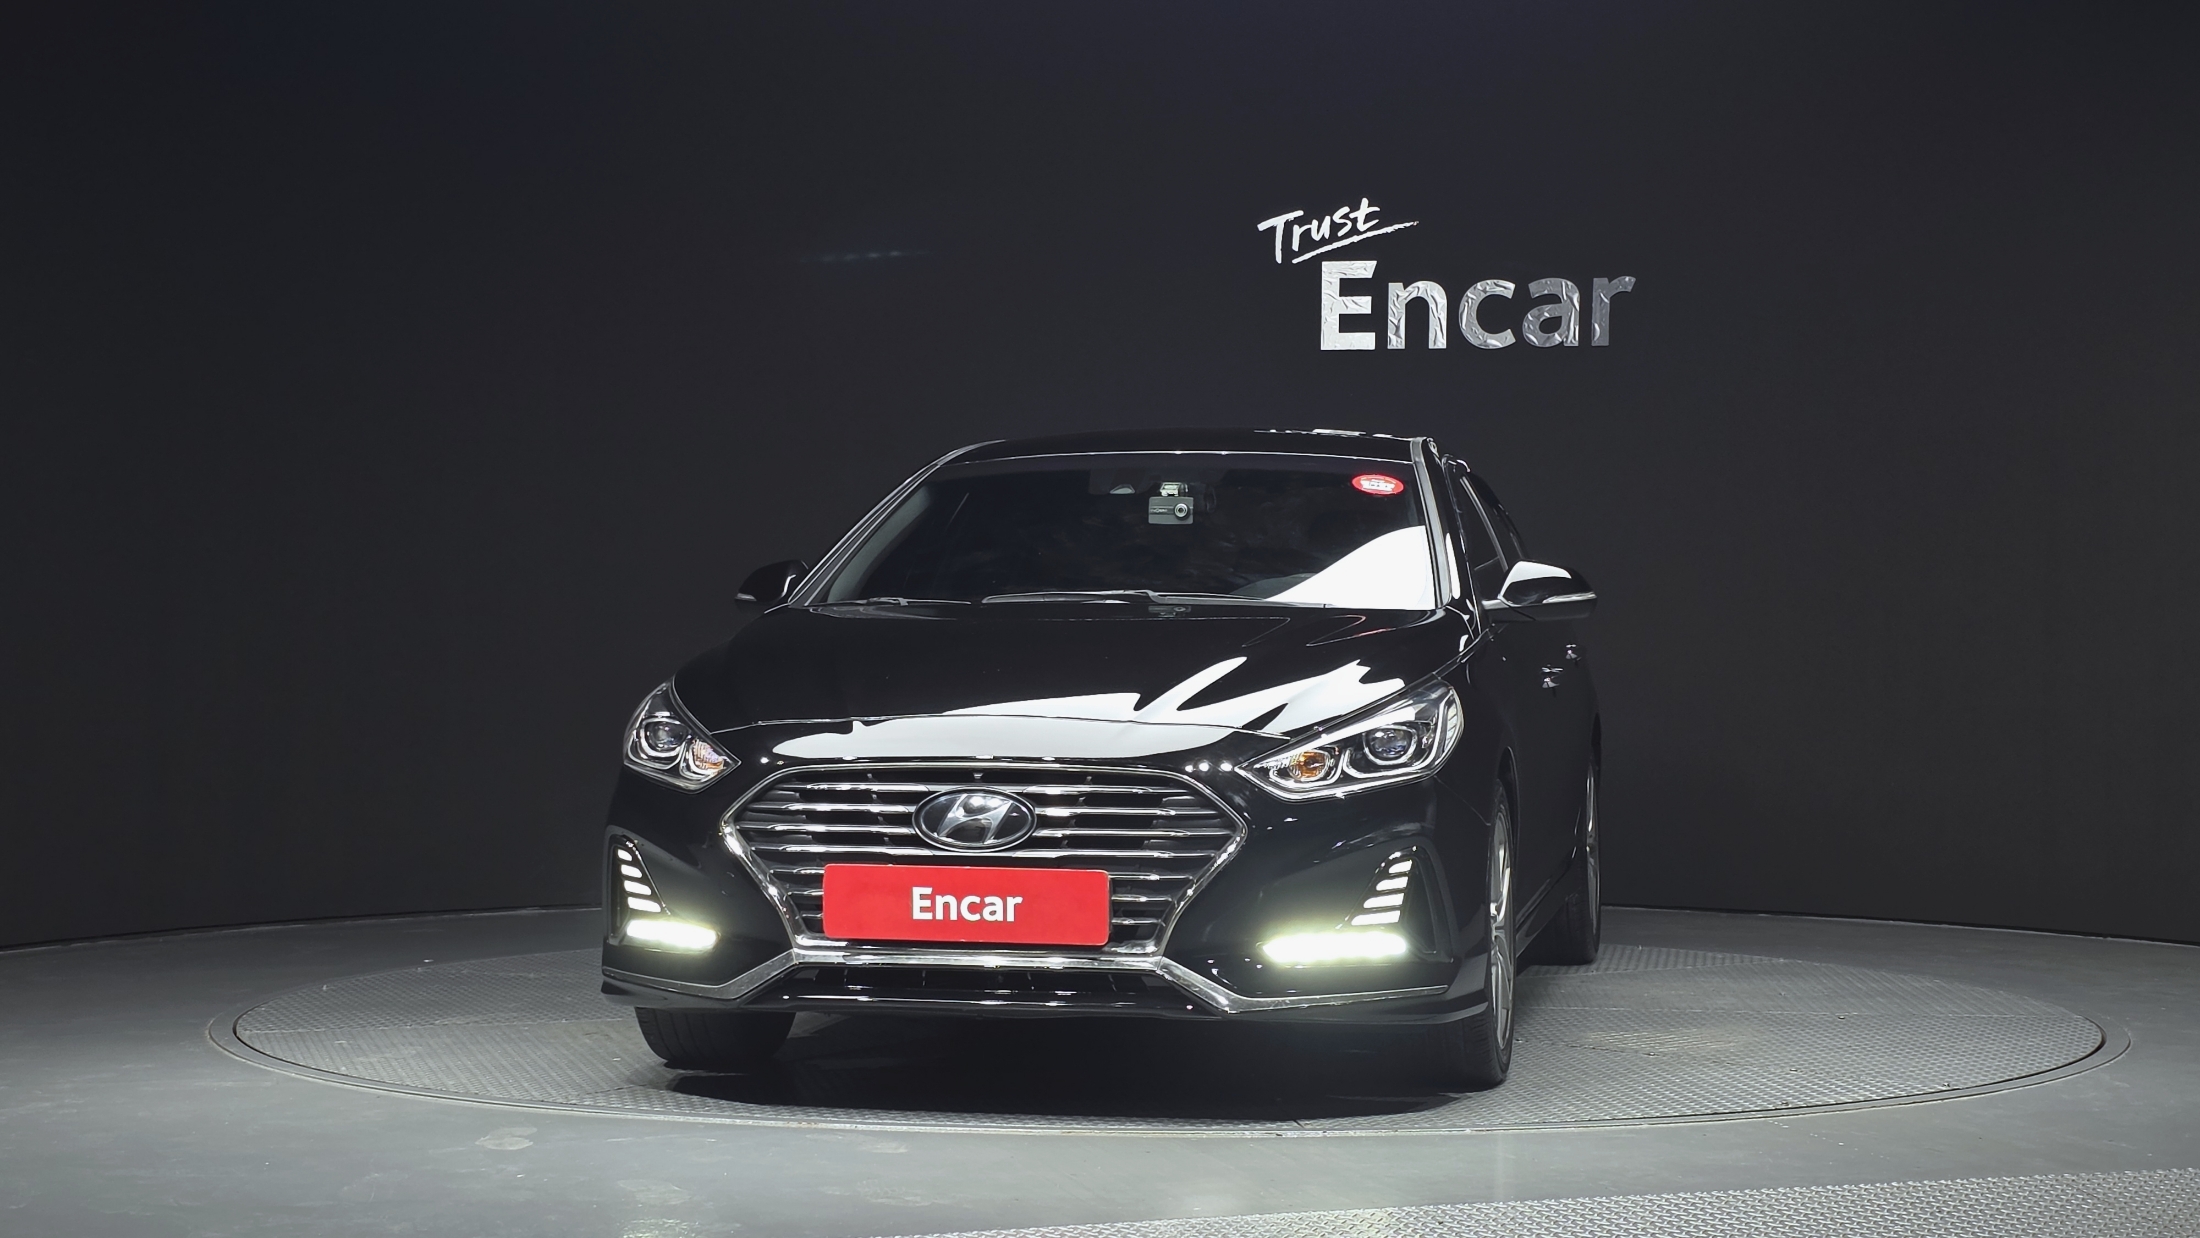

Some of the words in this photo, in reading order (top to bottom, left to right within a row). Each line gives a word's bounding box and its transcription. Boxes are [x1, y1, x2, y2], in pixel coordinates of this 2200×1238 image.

[1257, 197, 1381, 264] Trust
[1320, 260, 1637, 351] Encar
[911, 886, 1023, 923] Encar
